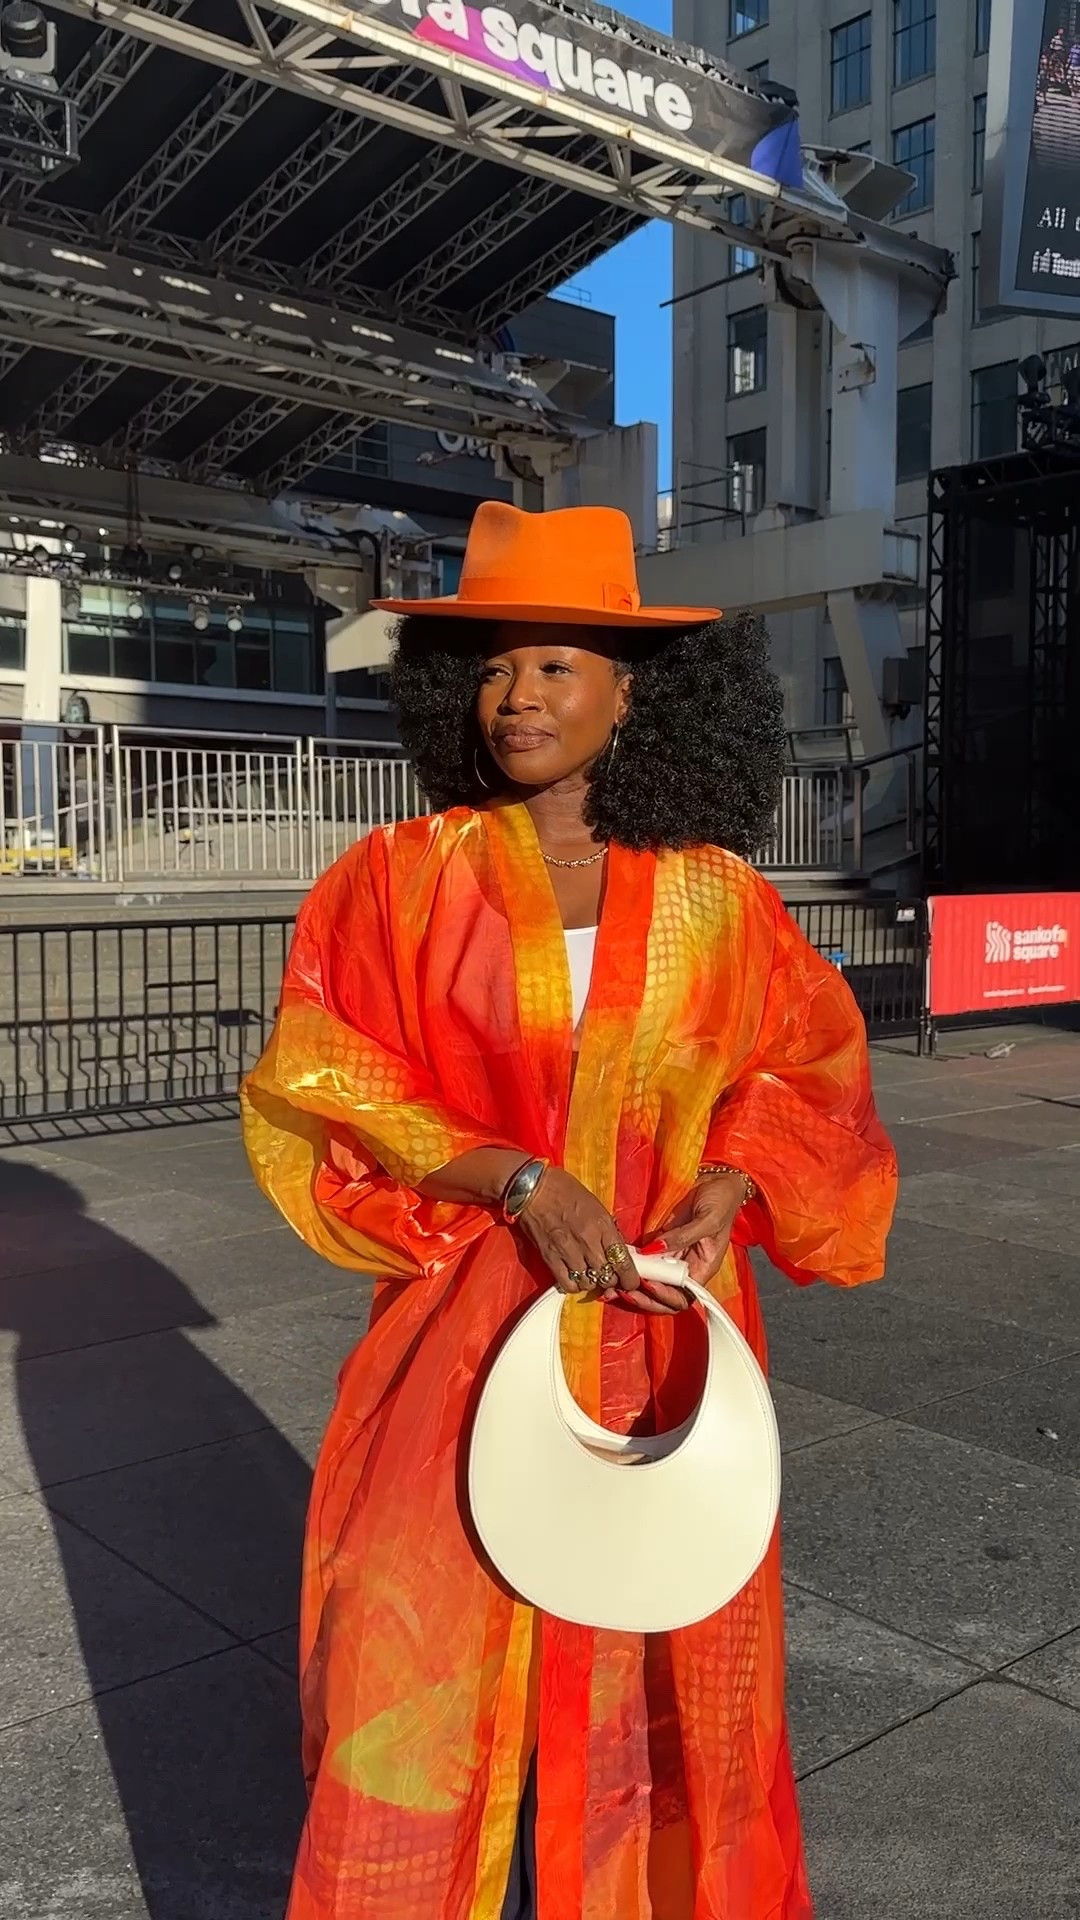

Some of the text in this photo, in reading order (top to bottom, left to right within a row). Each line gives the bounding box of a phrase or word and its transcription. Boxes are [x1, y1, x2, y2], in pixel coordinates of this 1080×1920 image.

[481, 7, 693, 131] square
[1037, 207, 1066, 229] All
[1013, 924, 1067, 946] sankofa
[1013, 944, 1059, 963] square
